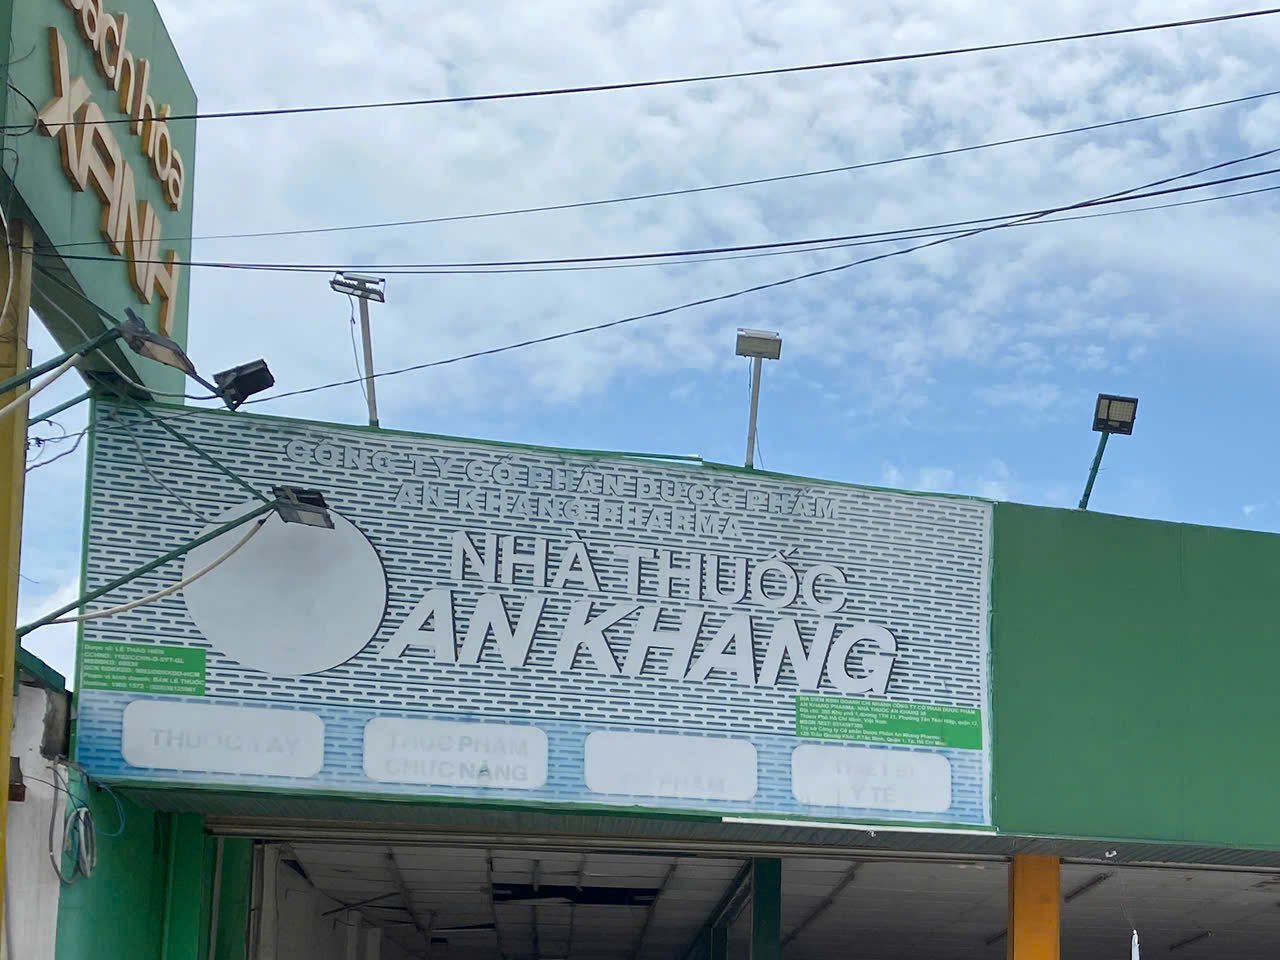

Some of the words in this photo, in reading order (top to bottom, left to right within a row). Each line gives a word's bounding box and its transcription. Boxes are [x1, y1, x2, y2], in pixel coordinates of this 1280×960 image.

[38, 26, 181, 338] XANH
[130, 58, 185, 212] hóa
[286, 438, 396, 474] CÔNG
[407, 454, 453, 479] TY
[466, 453, 520, 485] CỔ
[394, 483, 445, 508] AN
[457, 487, 589, 522] KHANG
[598, 503, 744, 537] PHARMA
[451, 530, 603, 592] NHÀ
[613, 546, 849, 614] THUỐC
[380, 589, 551, 668] AN
[554, 602, 900, 695] KHANG
